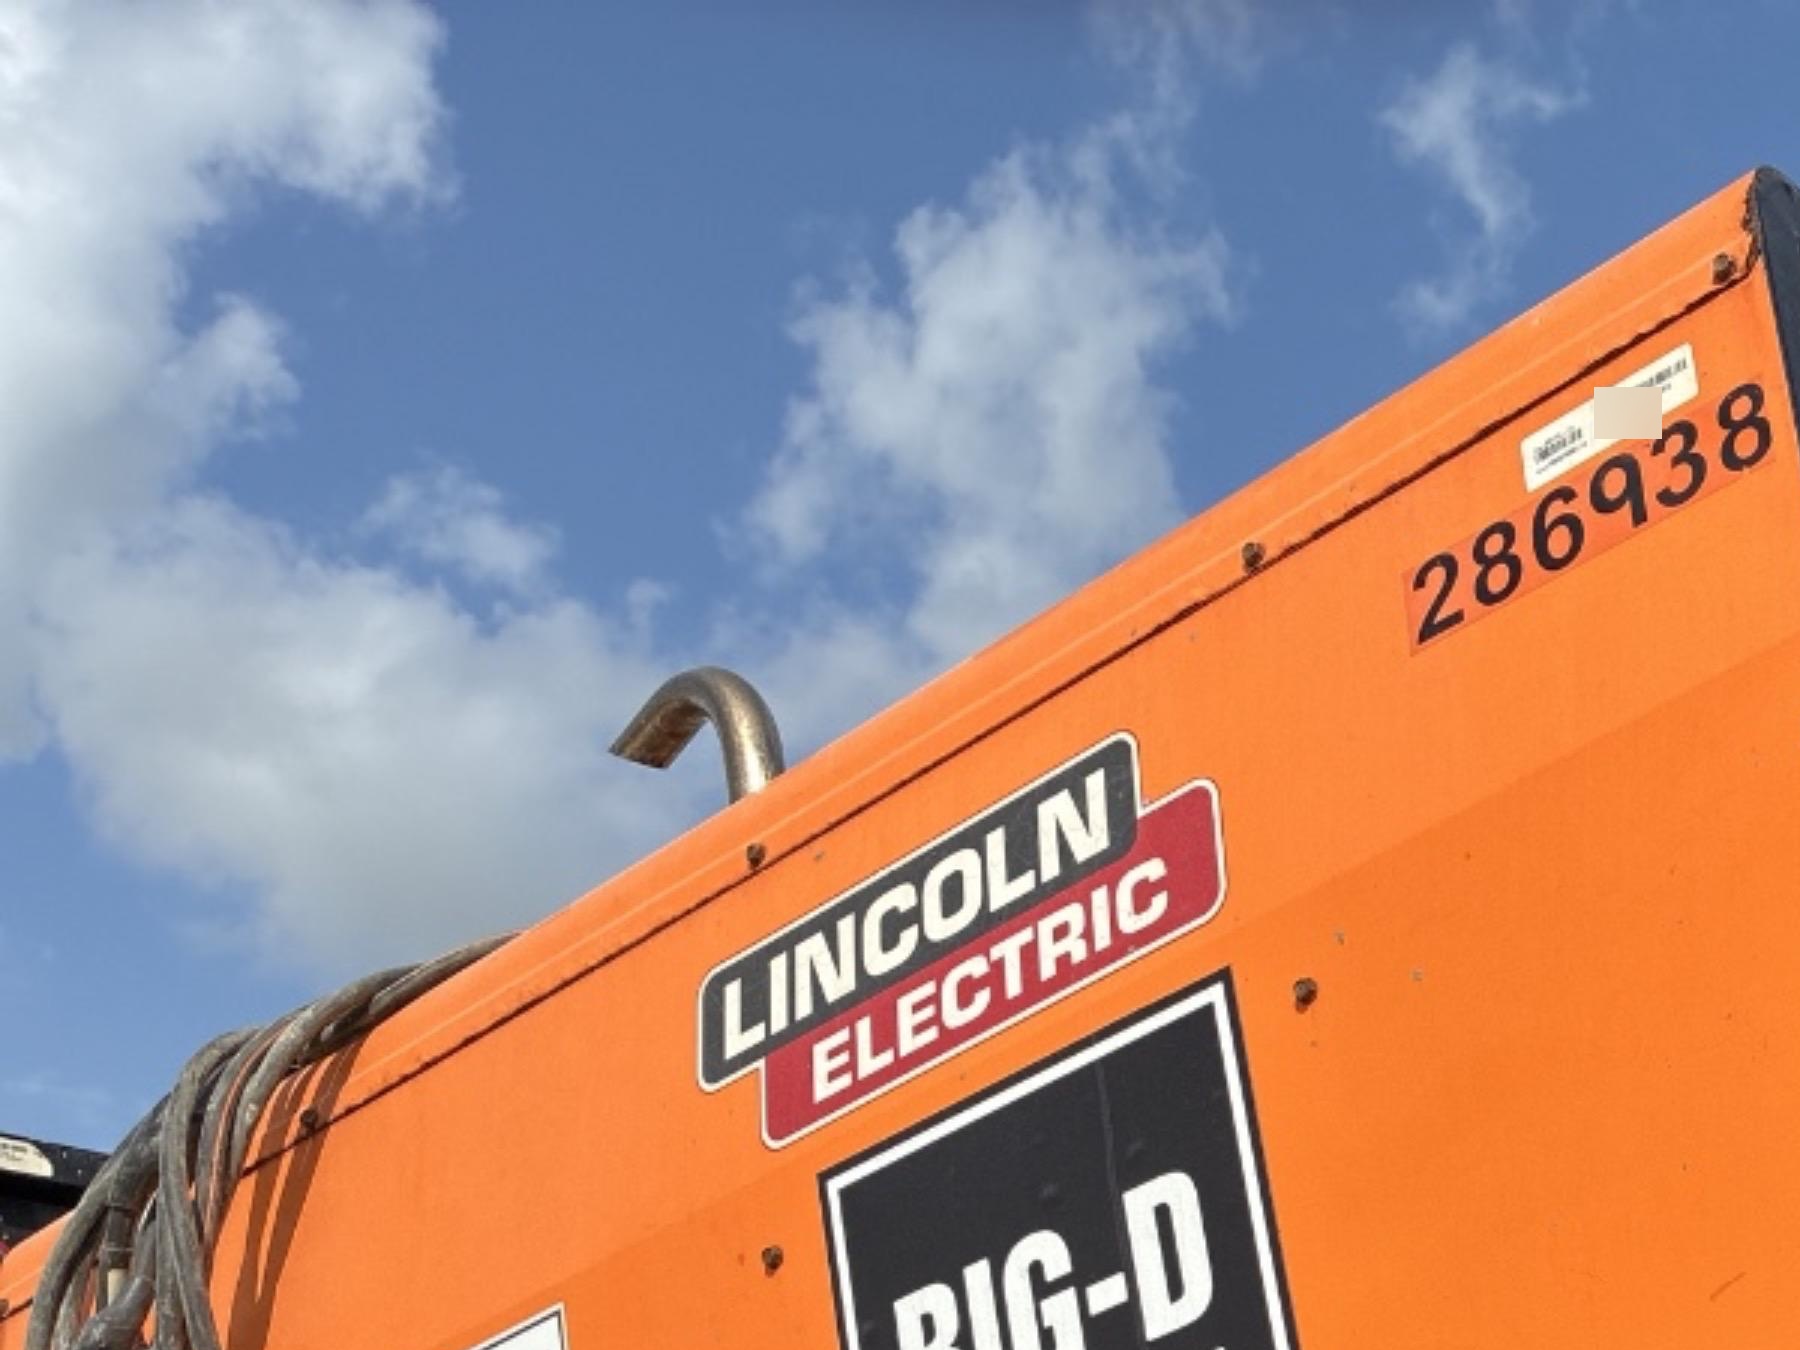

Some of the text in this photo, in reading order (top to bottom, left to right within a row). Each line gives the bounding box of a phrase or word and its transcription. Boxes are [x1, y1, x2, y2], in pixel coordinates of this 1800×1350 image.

[1411, 382, 1773, 646] 286938
[720, 767, 1111, 1062] LINCOLN
[810, 856, 1172, 1106] ELECTRIC
